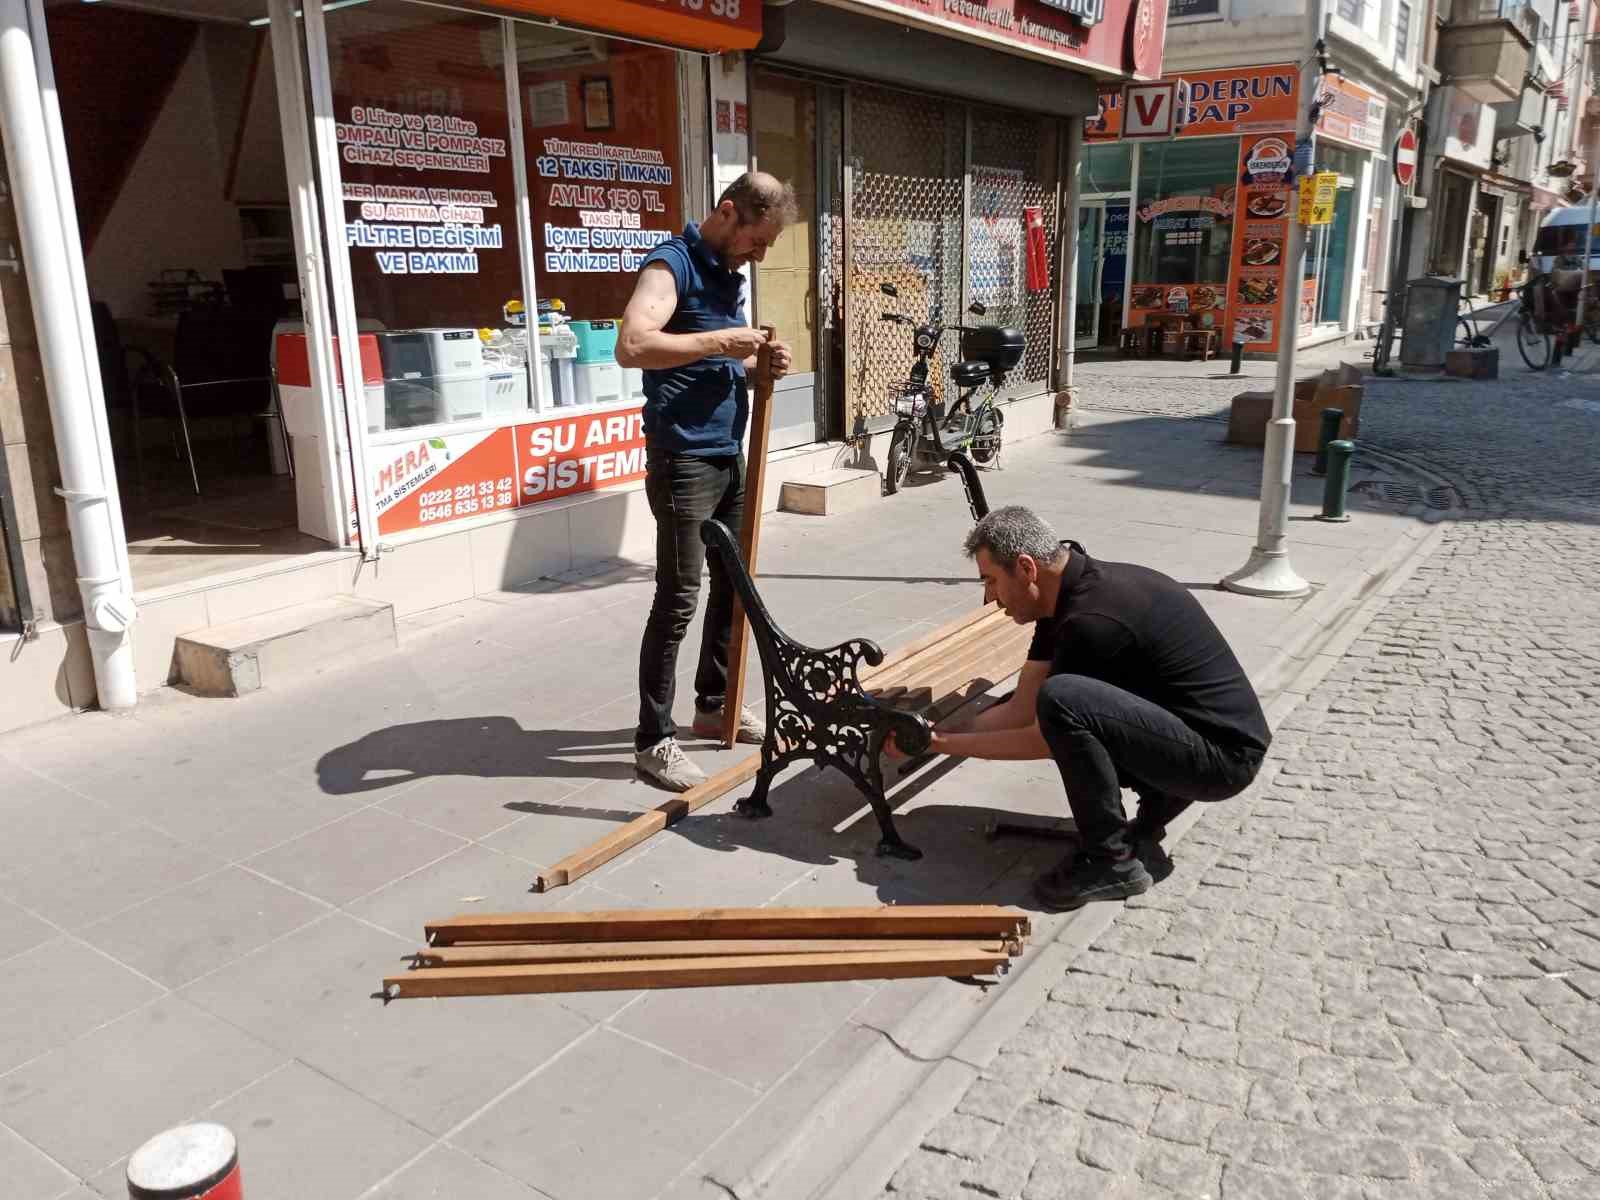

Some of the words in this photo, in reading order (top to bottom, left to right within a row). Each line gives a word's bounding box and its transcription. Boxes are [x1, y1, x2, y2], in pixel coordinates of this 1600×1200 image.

[1179, 74, 1293, 102] DERUN
[353, 107, 364, 122] 8
[367, 109, 402, 127] Litre
[404, 114, 423, 128] ve
[426, 115, 442, 131] 12
[445, 117, 477, 134] Litre
[1134, 94, 1165, 127] V
[336, 124, 400, 146] OMPALI
[402, 131, 424, 148] VE
[544, 138, 569, 155] TÜM
[537, 158, 558, 176] 12
[561, 160, 616, 180] TAKSİT
[620, 164, 672, 184] İMKANI
[342, 184, 373, 200] HER
[375, 185, 429, 204] MARKA
[430, 189, 448, 205] VE
[449, 190, 497, 207] MODEL
[549, 184, 605, 207] AYLIK
[608, 190, 641, 210] 150
[643, 192, 665, 211] TL
[362, 204, 384, 220] SU
[386, 205, 440, 222] ARITMA
[580, 211, 620, 227] TAKSİT
[622, 212, 640, 228] İLE
[345, 221, 415, 248] FİLTRE
[418, 223, 502, 253] DEĞİŞİMİ
[545, 224, 589, 251] İÇME
[377, 252, 407, 273] VE
[410, 253, 479, 273] BAKIMI
[546, 250, 620, 272] EVİNİZDE
[530, 427, 577, 457] SU
[583, 413, 646, 448] ARIT
[376, 495, 393, 511] TMA
[420, 488, 452, 507] 0222
[454, 484, 476, 500] 221
[479, 480, 494, 494] 33
[496, 477, 512, 490] 42
[420, 504, 452, 521] 0546
[455, 498, 478, 513] 635
[481, 495, 494, 508] 13
[497, 492, 512, 505] 38
